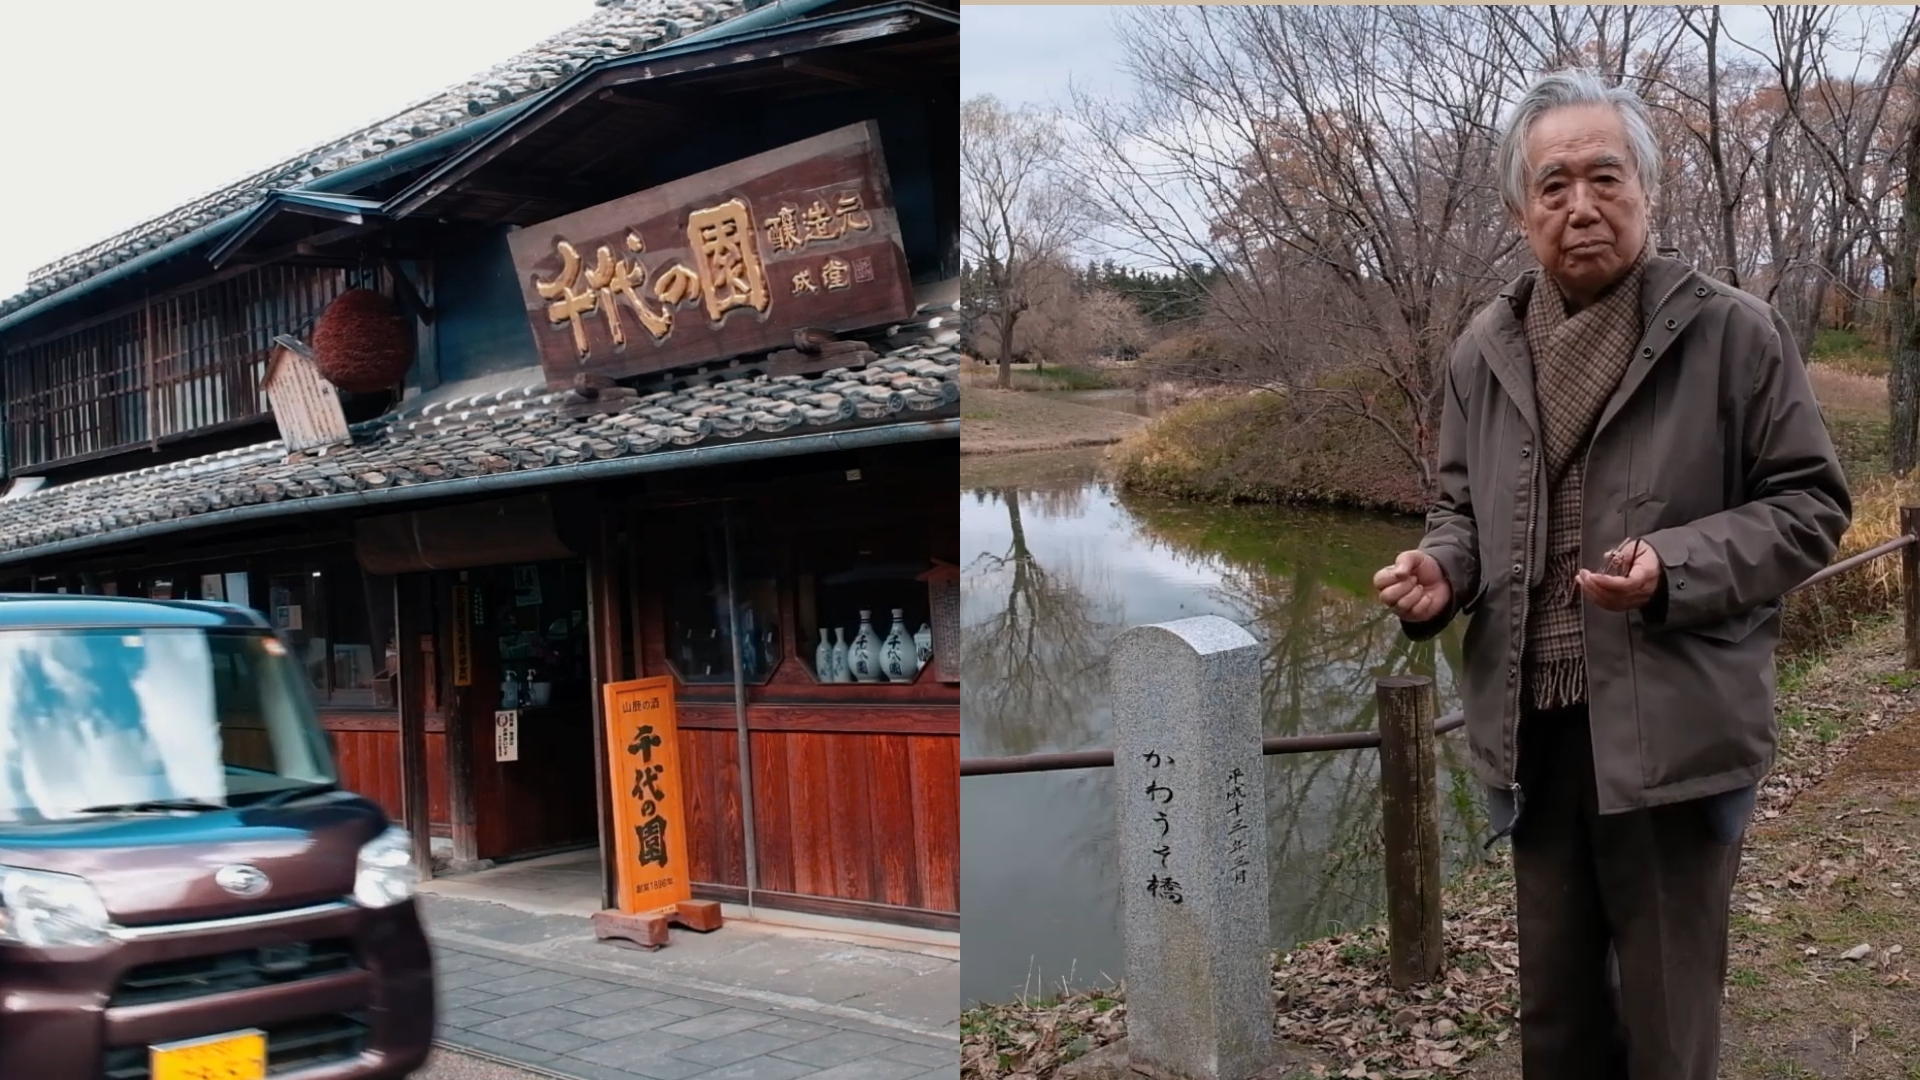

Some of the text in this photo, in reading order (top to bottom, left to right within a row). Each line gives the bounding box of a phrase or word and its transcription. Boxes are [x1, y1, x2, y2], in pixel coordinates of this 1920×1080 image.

[536, 199, 770, 357] 千代の園
[622, 697, 660, 713] 山鹿の酒
[627, 725, 668, 868] 千代の園
[1143, 750, 1184, 904] かわうそ橋
[1225, 767, 1250, 884] 平成十三年三月
[636, 877, 674, 893] 創業1896年
